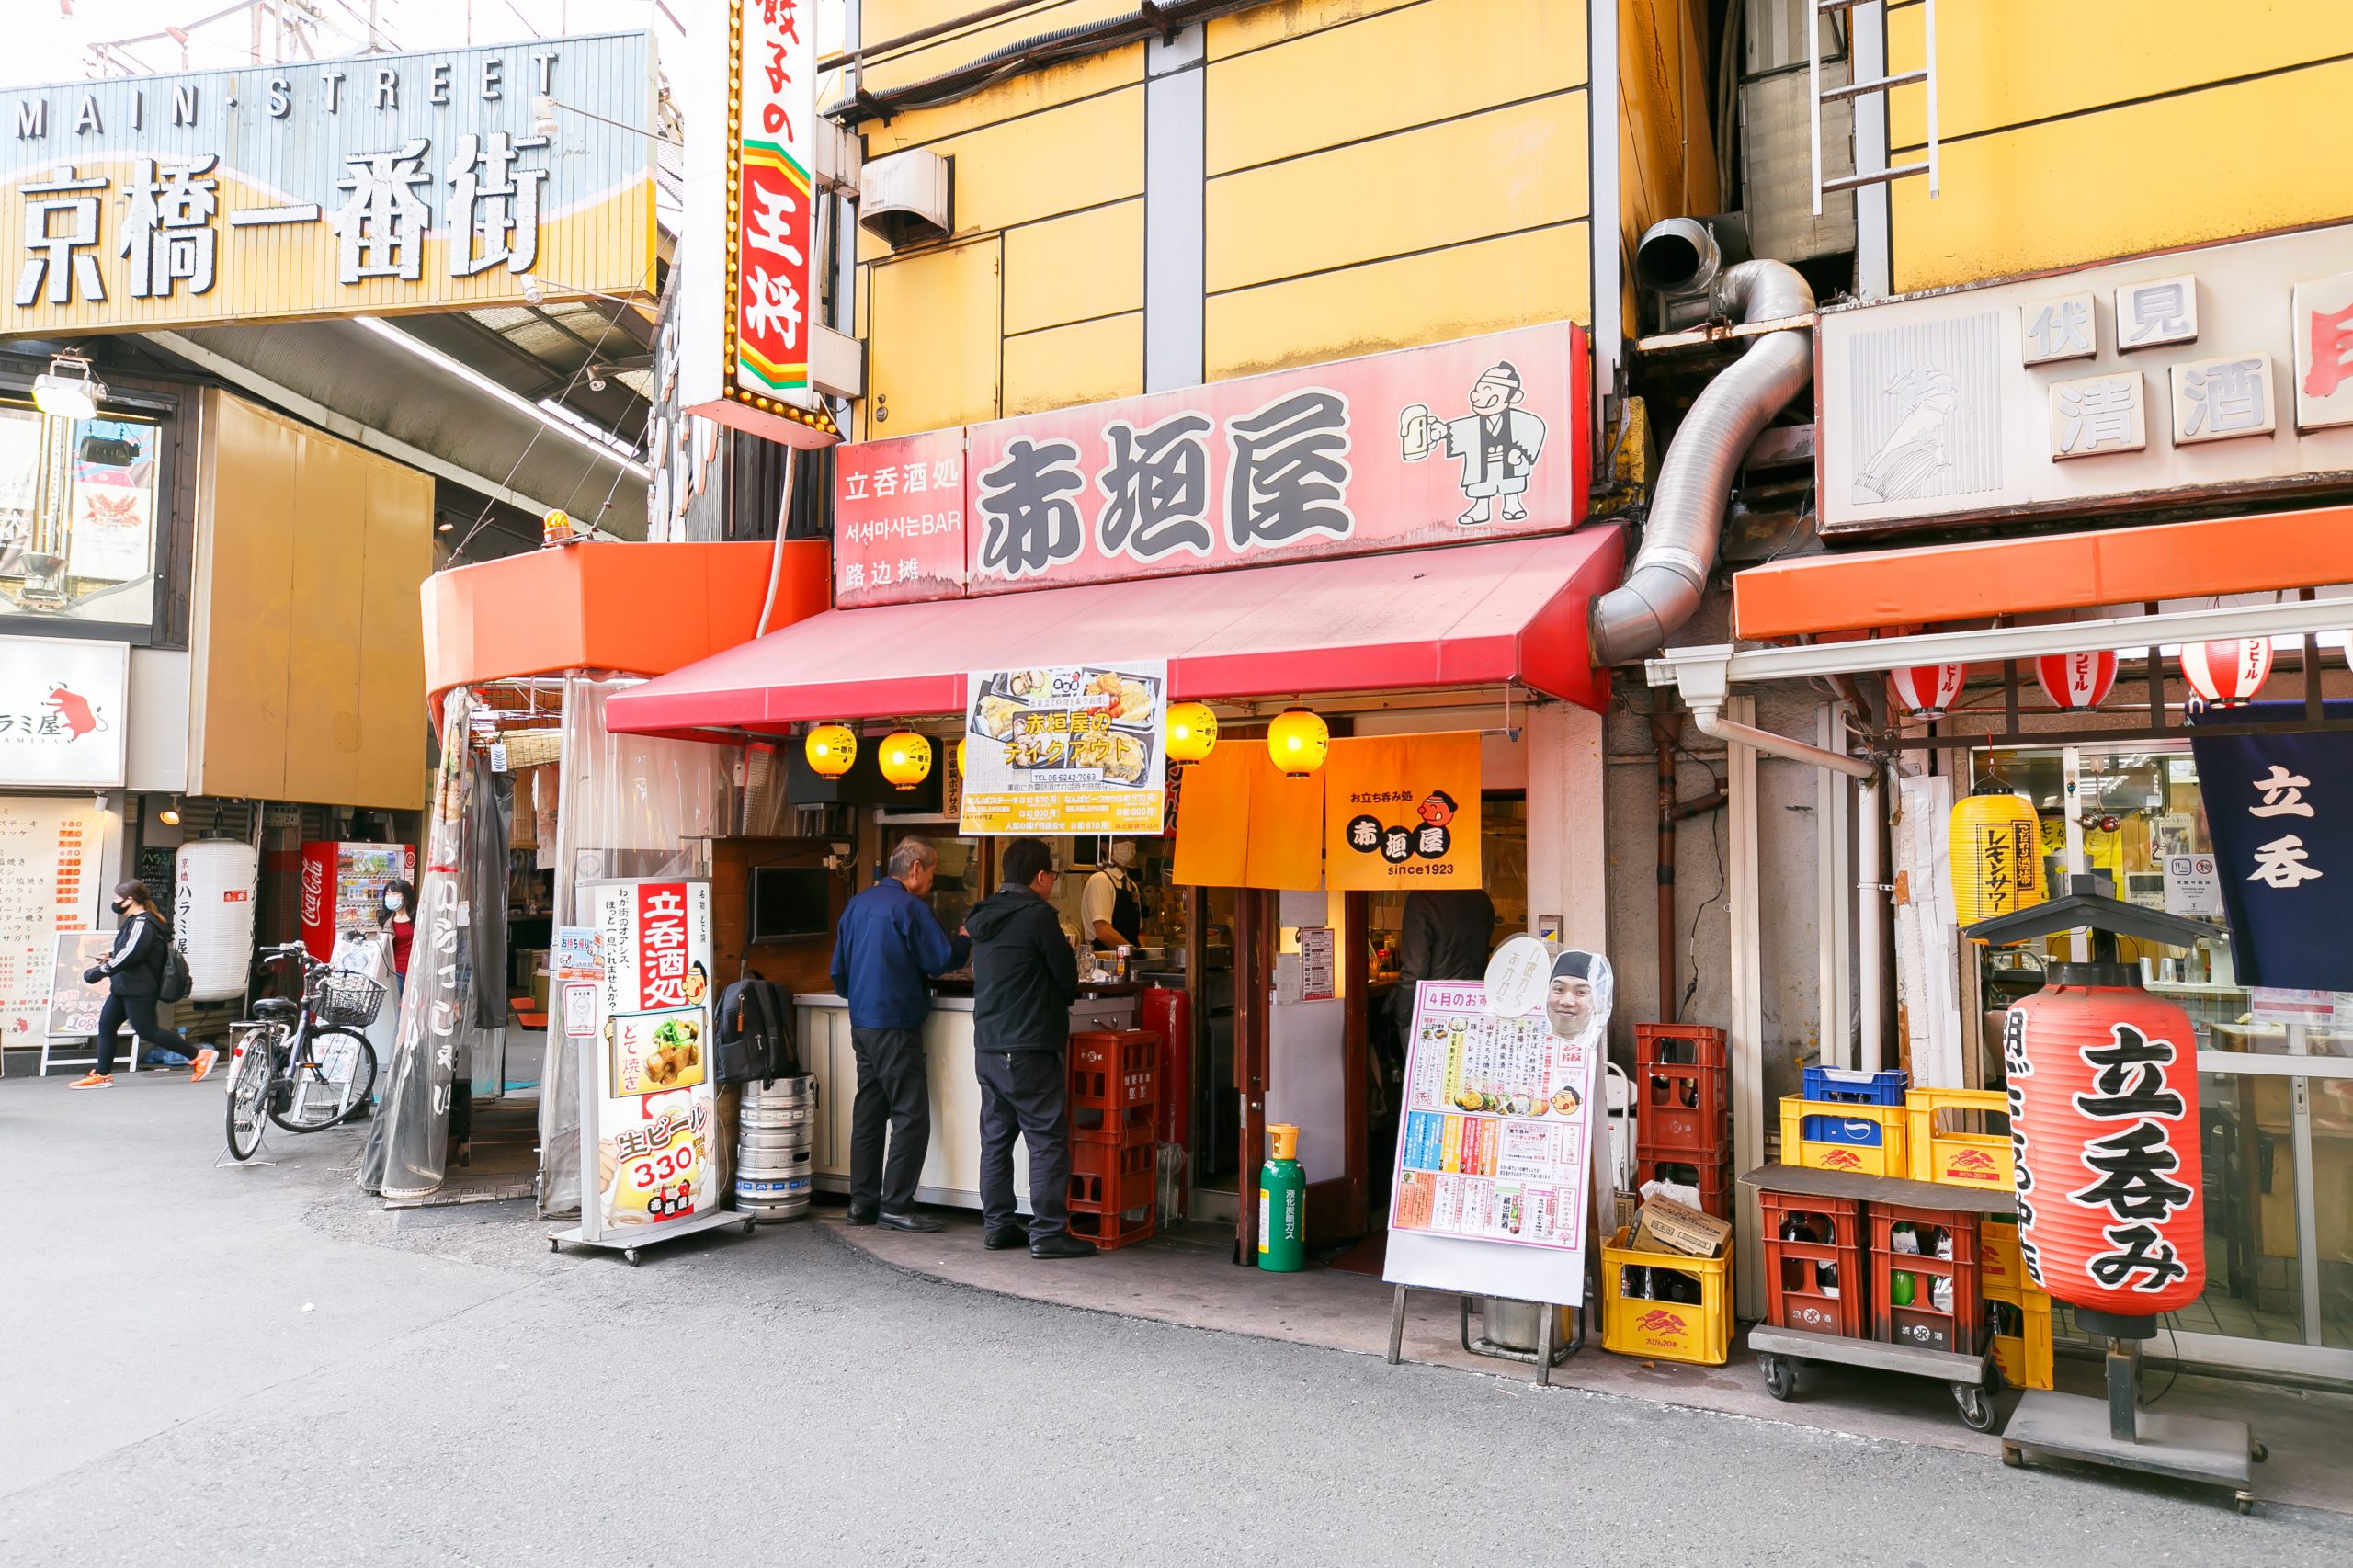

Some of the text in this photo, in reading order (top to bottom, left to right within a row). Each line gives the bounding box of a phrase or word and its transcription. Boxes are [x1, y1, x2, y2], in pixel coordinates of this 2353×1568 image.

[15, 52, 559, 139] MAIN STREET
[14, 131, 551, 306] 京橋一番街
[745, 179, 803, 350] 王将
[2028, 282, 2190, 356] 伏見
[2058, 358, 2265, 452] 清酒
[845, 458, 959, 501] 立呑酒処
[977, 386, 1356, 576] 赤垣屋
[845, 557, 919, 586] 路边摊
[1003, 738, 1131, 765] テイクアウト
[1025, 711, 1112, 735] 赤垣屋の
[948, 749, 958, 814] 自家製ポテサラ
[1350, 790, 1414, 803] お立ち呑み処
[1353, 821, 1444, 858] 赤垣屋
[2018, 824, 2032, 885] こだわり酒場
[2246, 765, 2324, 889] 立呑
[301, 856, 324, 927] Coca-Cola
[1984, 830, 2012, 912] レモンサワー
[643, 890, 687, 1008] 立呑酒処
[622, 1022, 641, 1092] どて焼き
[619, 1105, 706, 1162] 生ビール
[634, 1146, 691, 1189] 330
[2071, 1023, 2193, 1290] 立呑み
